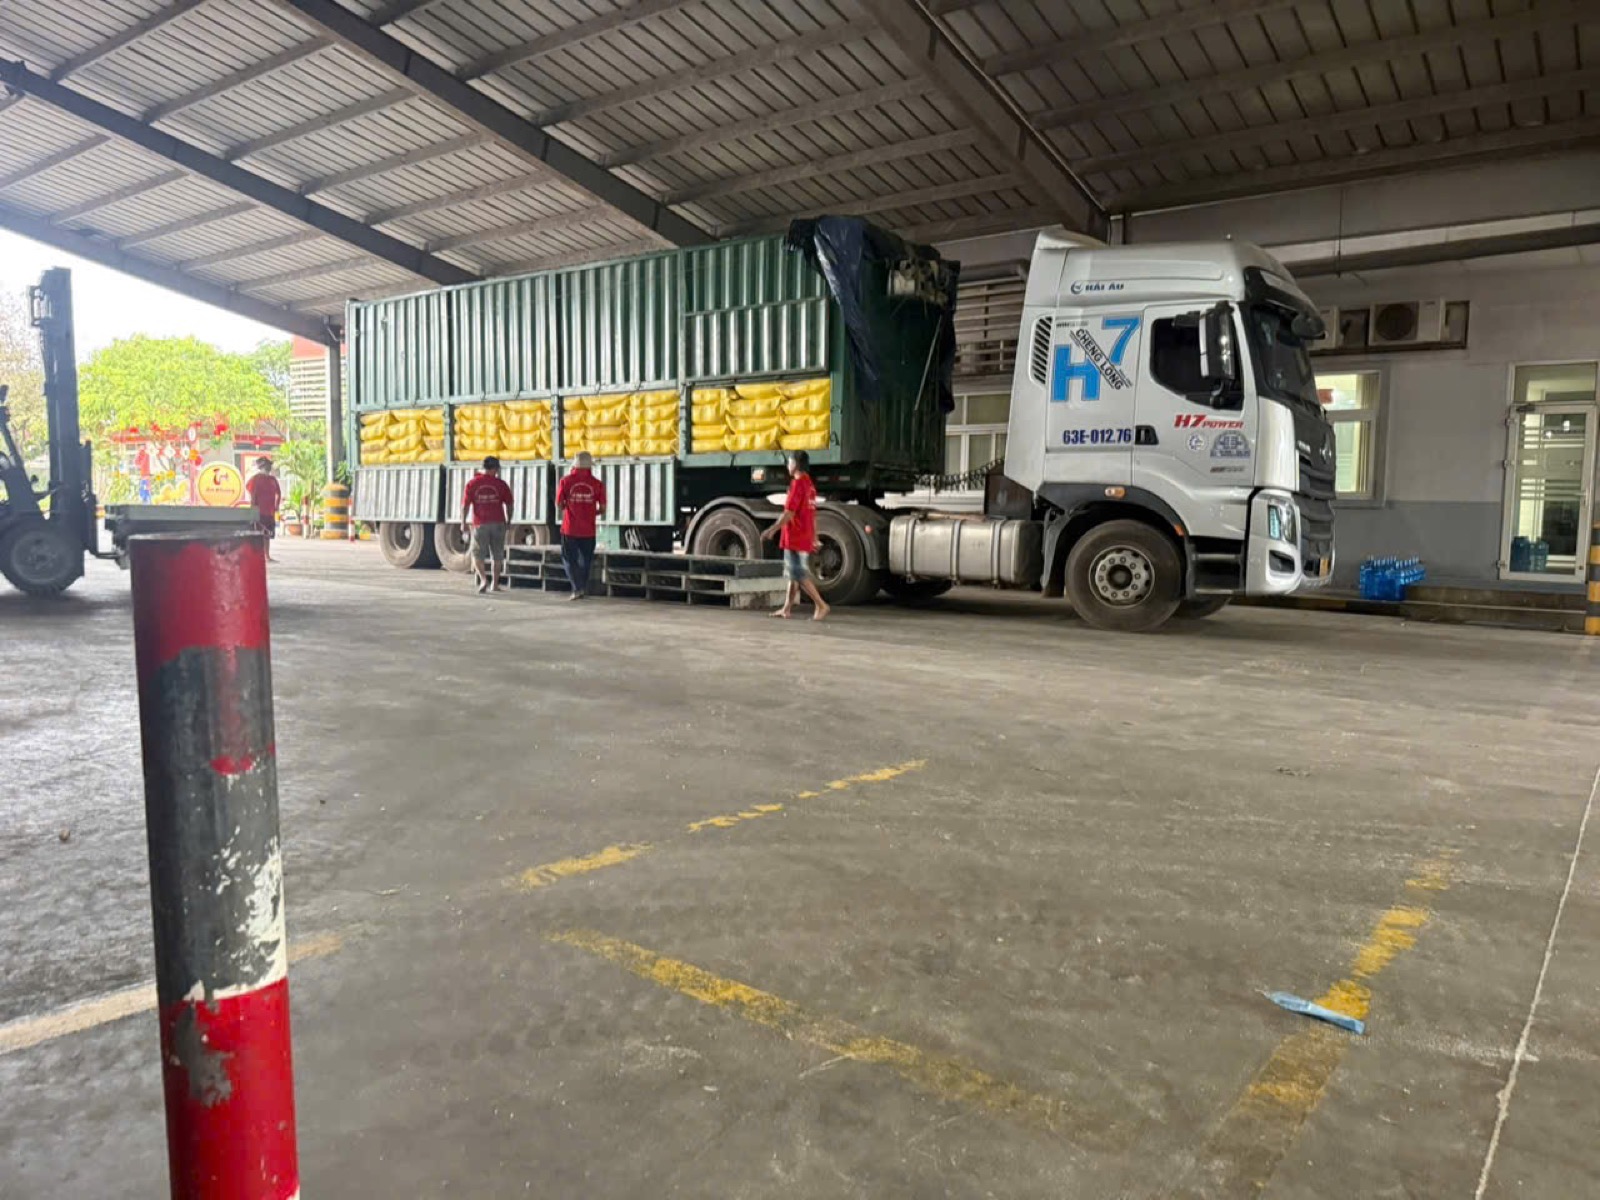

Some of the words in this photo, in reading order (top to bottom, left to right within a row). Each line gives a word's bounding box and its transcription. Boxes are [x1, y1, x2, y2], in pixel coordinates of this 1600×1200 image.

[1075, 328, 1103, 362] CHENG
[1099, 360, 1124, 390] LONG
[1174, 414, 1207, 428] H7
[1063, 428, 1132, 445] 63E-012.76
